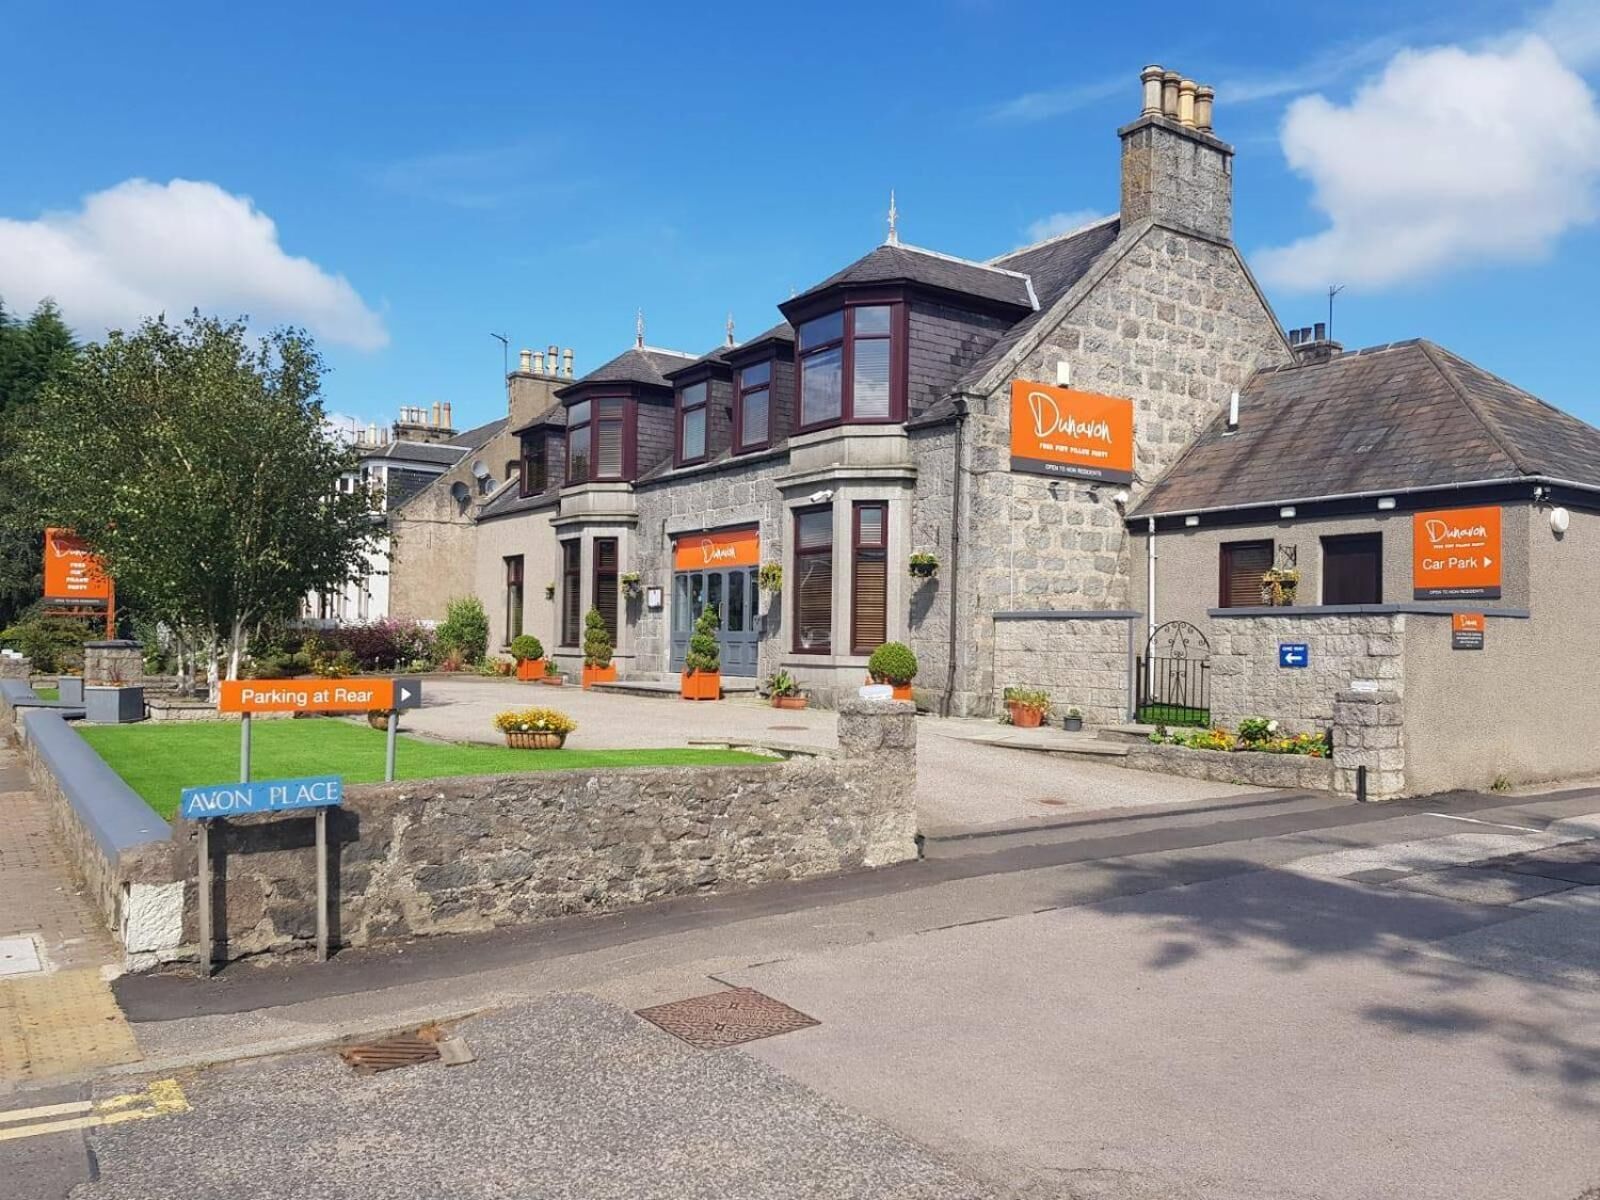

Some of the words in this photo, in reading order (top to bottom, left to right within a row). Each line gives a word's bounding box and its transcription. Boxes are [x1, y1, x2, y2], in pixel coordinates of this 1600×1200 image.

[1028, 391, 1112, 444] Dunavon
[1425, 519, 1488, 543] Dunavon
[1422, 558, 1445, 571] Car
[1448, 557, 1478, 569] Park
[241, 688, 307, 707] Parking
[313, 689, 329, 703] at
[335, 688, 373, 703] Rear
[188, 789, 252, 813] AVON
[270, 782, 338, 805] PLACE
